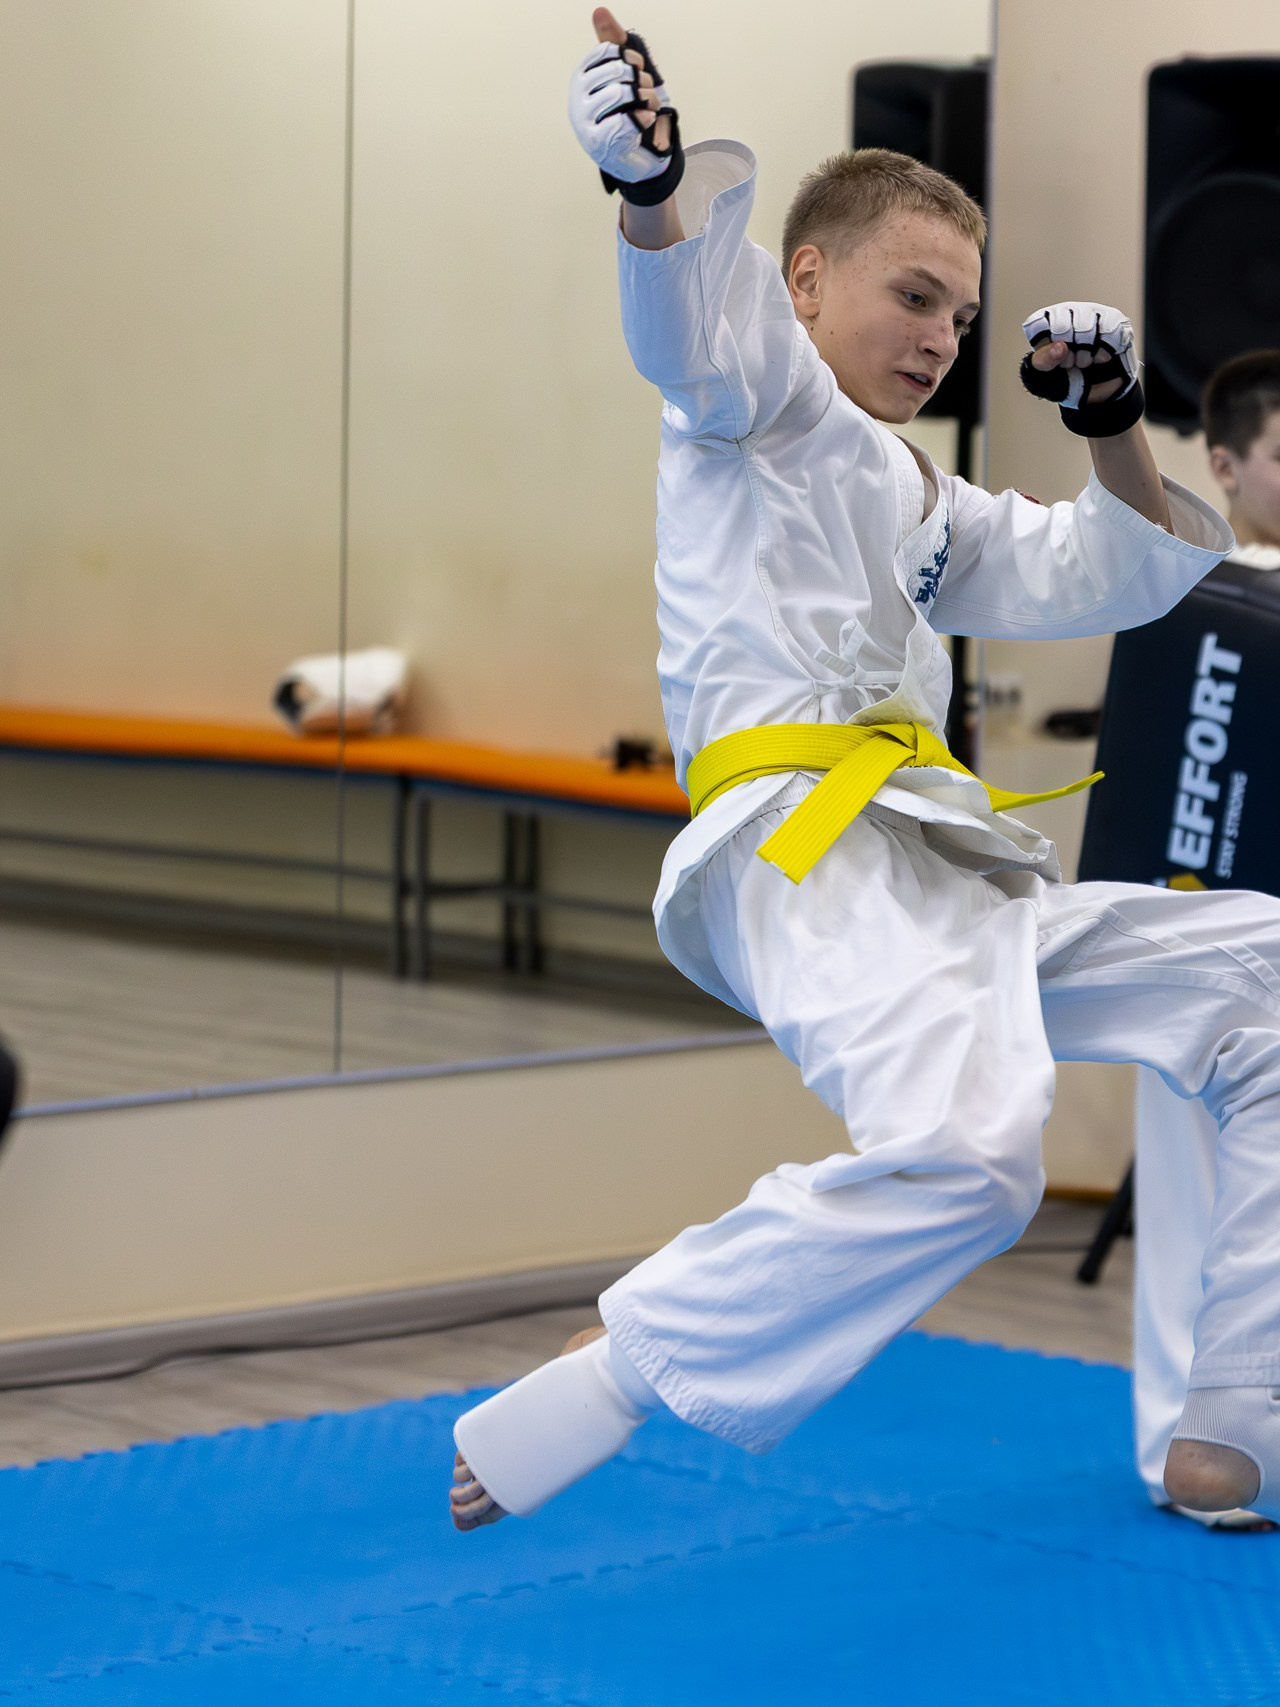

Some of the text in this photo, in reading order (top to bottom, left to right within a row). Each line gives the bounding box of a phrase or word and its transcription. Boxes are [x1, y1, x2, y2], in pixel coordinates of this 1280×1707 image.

[1166, 632, 1243, 870] EFFORT
[1216, 771, 1248, 879] STAY STRONG
